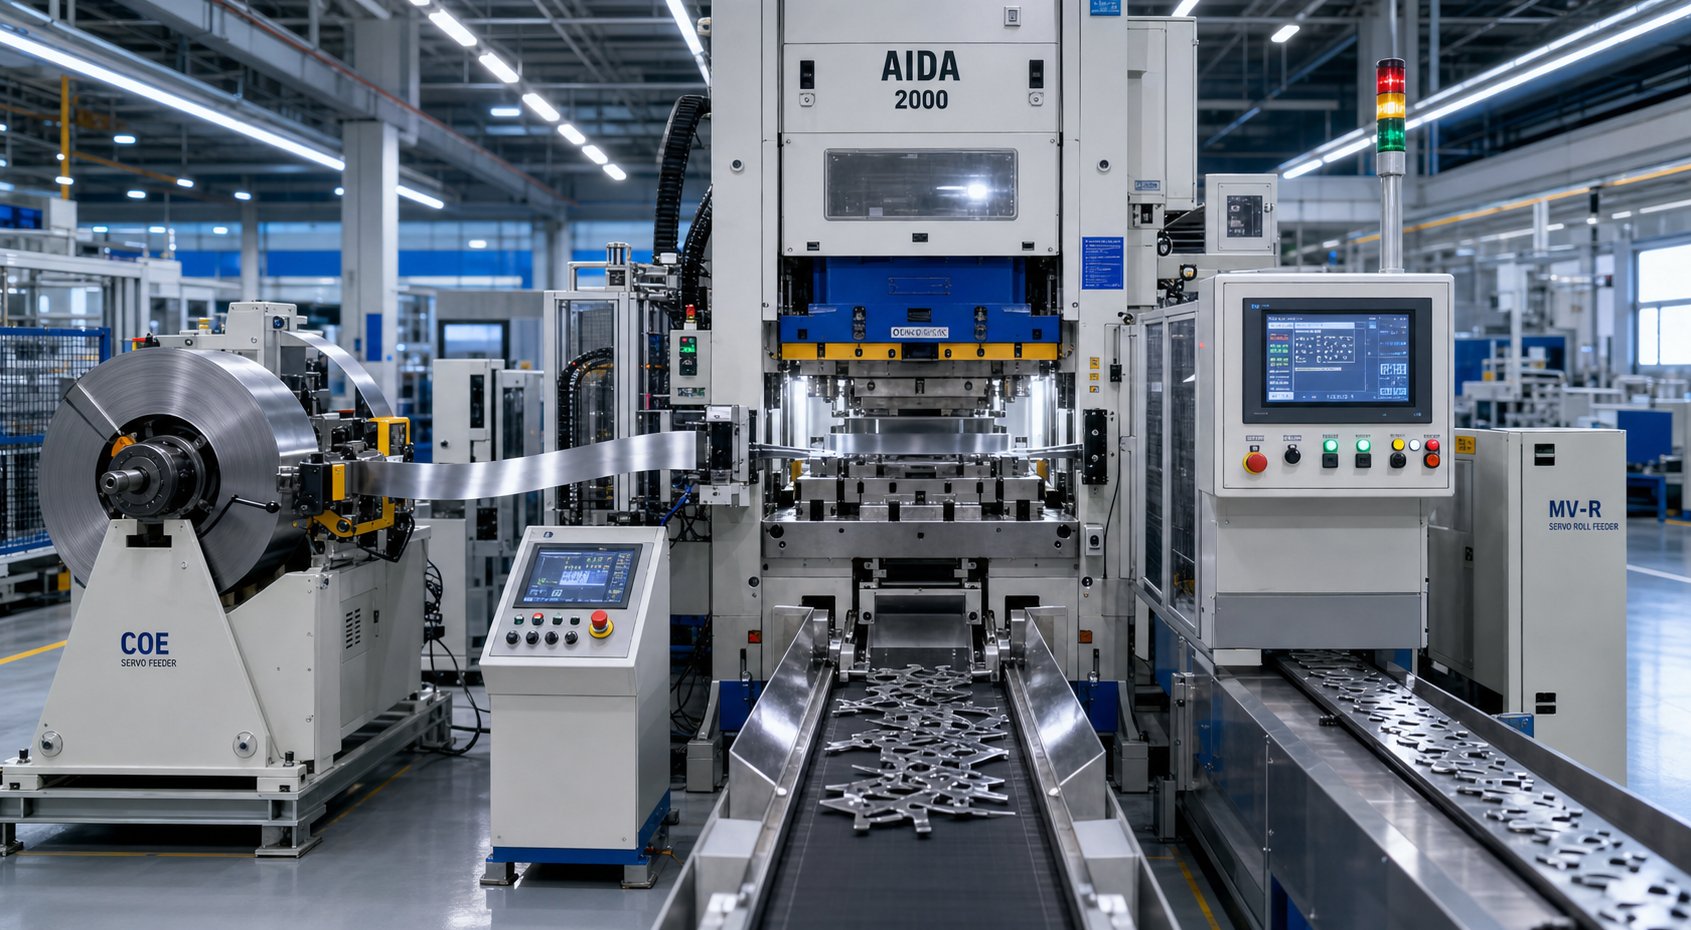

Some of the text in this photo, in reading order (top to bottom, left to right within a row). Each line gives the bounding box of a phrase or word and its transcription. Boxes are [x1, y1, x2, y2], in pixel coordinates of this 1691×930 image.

[881, 50, 960, 81] AIDA
[895, 89, 948, 109] 2000
[1549, 500, 1602, 518] MV-R
[1549, 522, 1619, 531] SERVO ROLL FEEDER
[121, 631, 169, 655] COE
[121, 658, 177, 668] SERVO FEEDER
